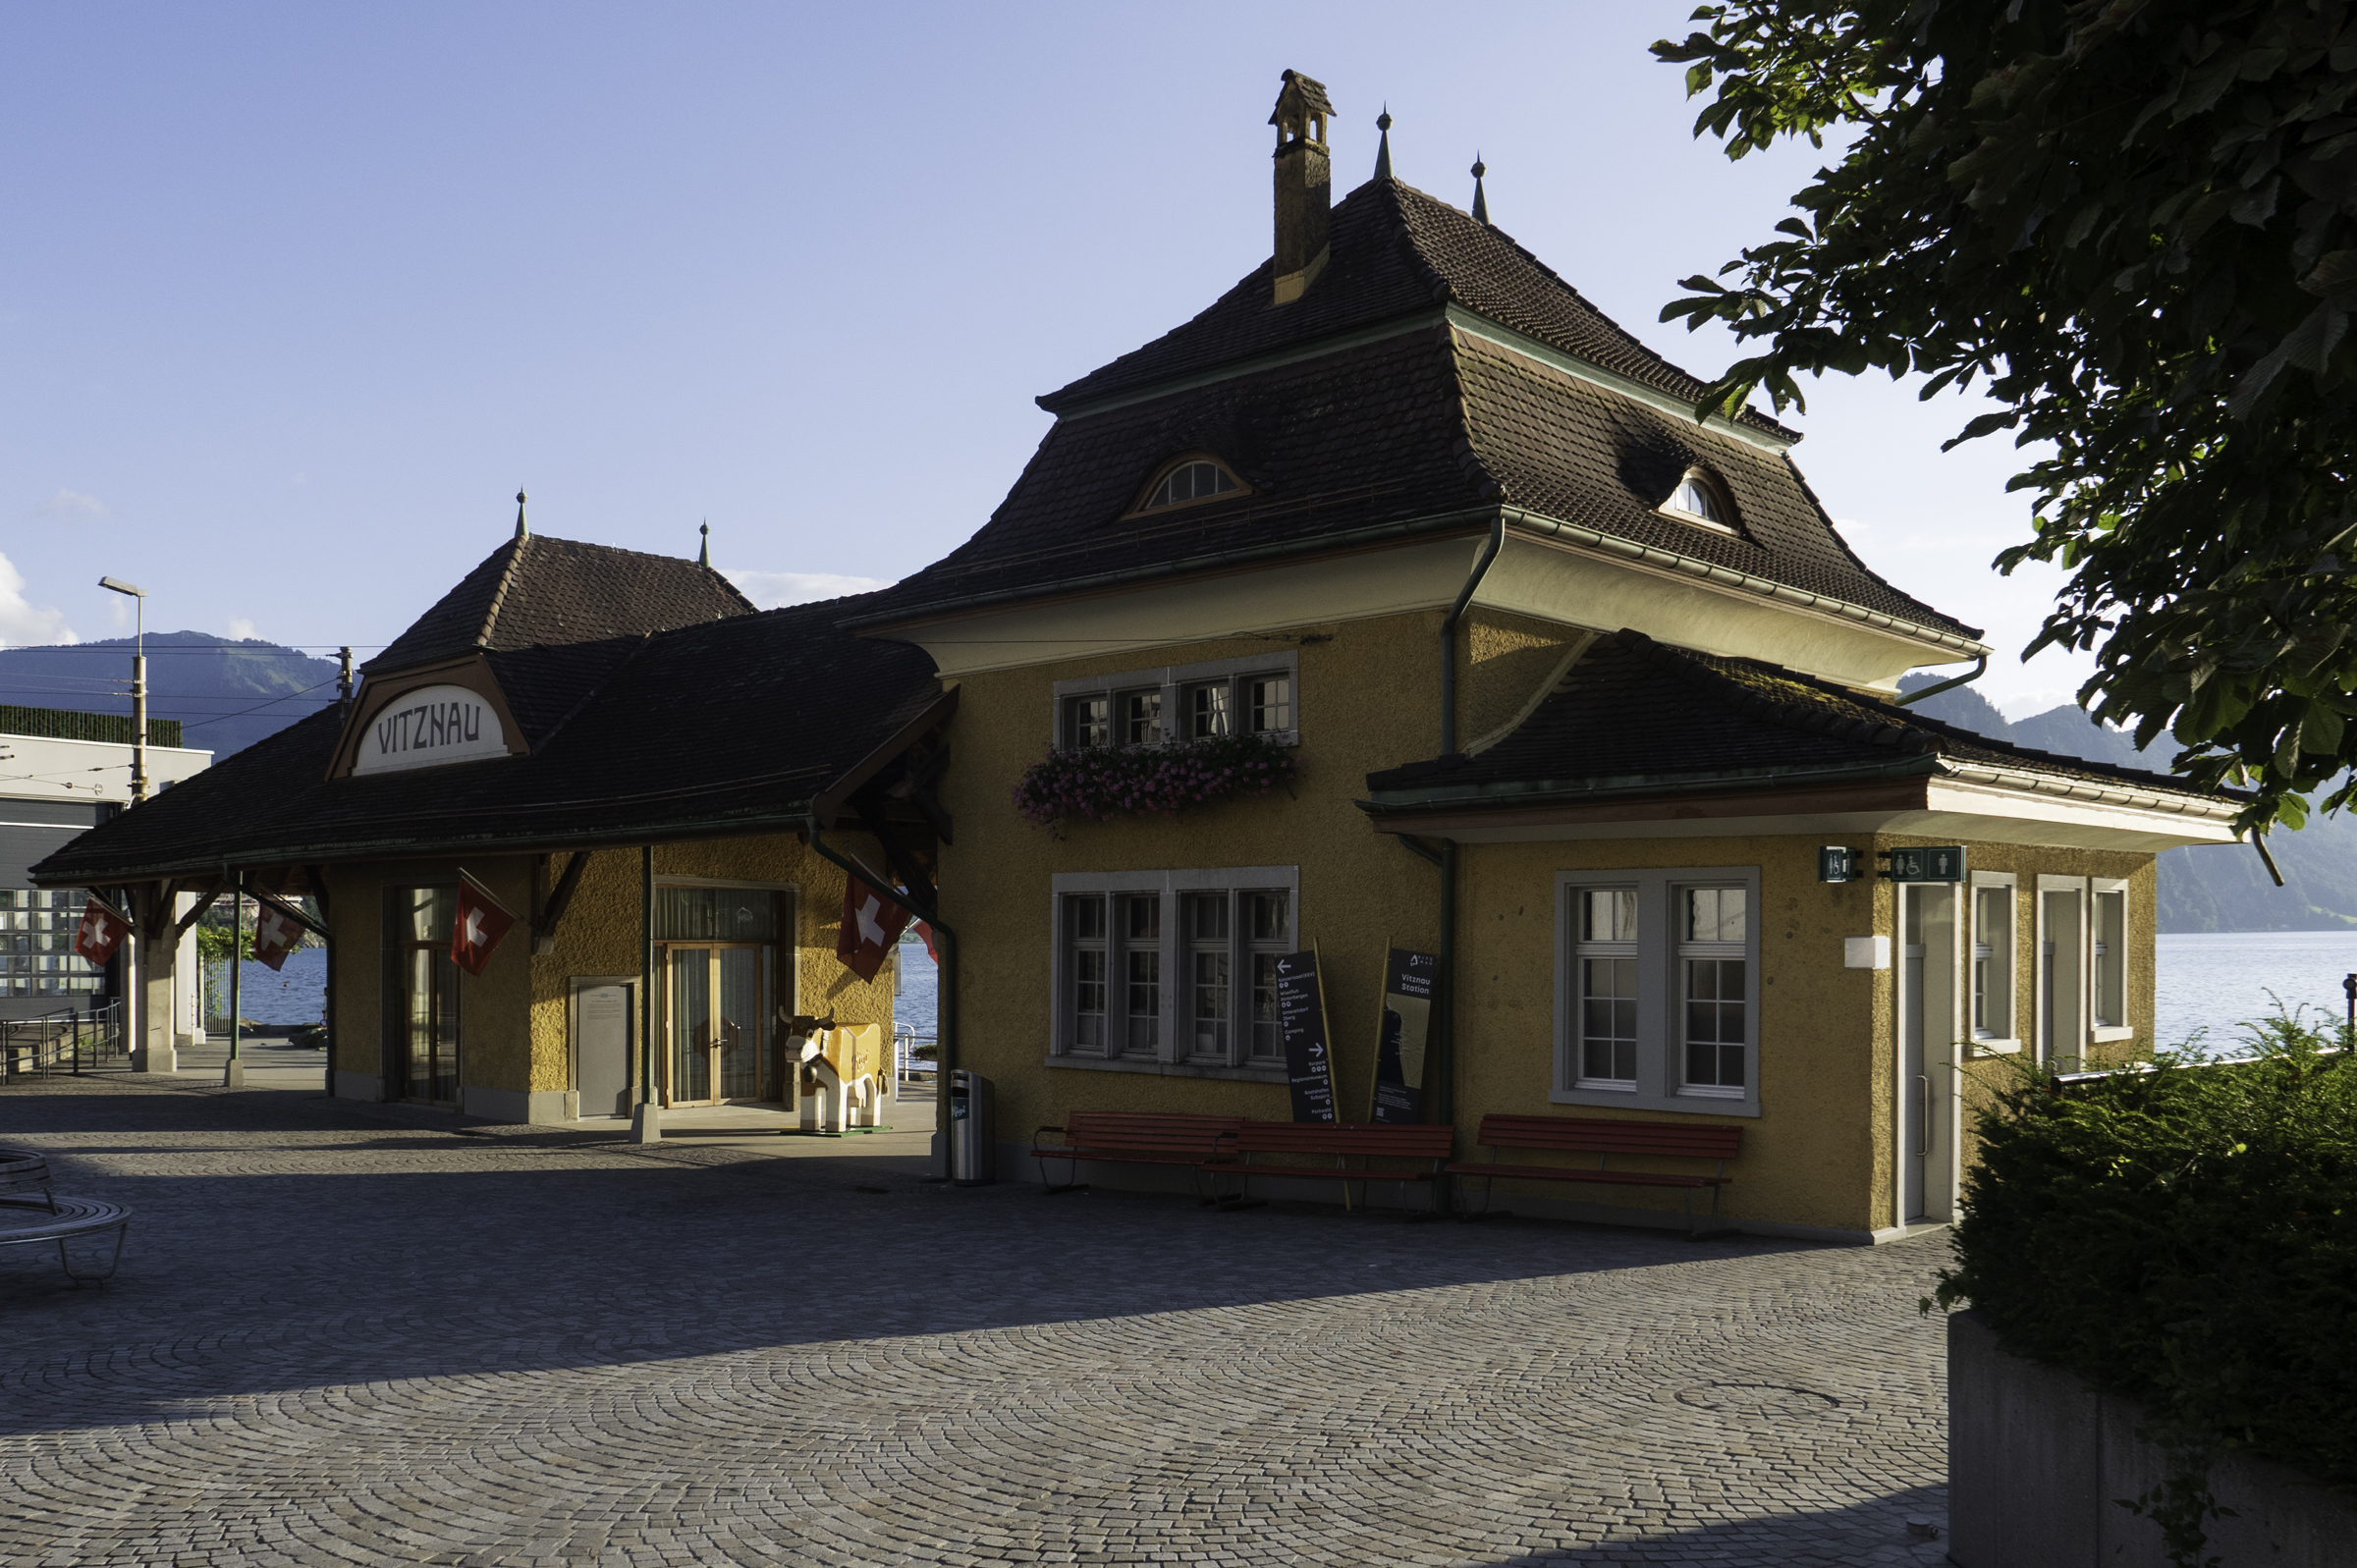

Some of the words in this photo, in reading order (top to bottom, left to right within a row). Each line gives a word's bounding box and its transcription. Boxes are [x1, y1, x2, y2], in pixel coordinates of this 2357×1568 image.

[378, 702, 480, 754] VITZNAU
[1401, 973, 1430, 985] Vitznau
[1401, 983, 1430, 995] Station
[1291, 1074, 1327, 1083] Regionalmuseum
[953, 1105, 966, 1117] Rigi
